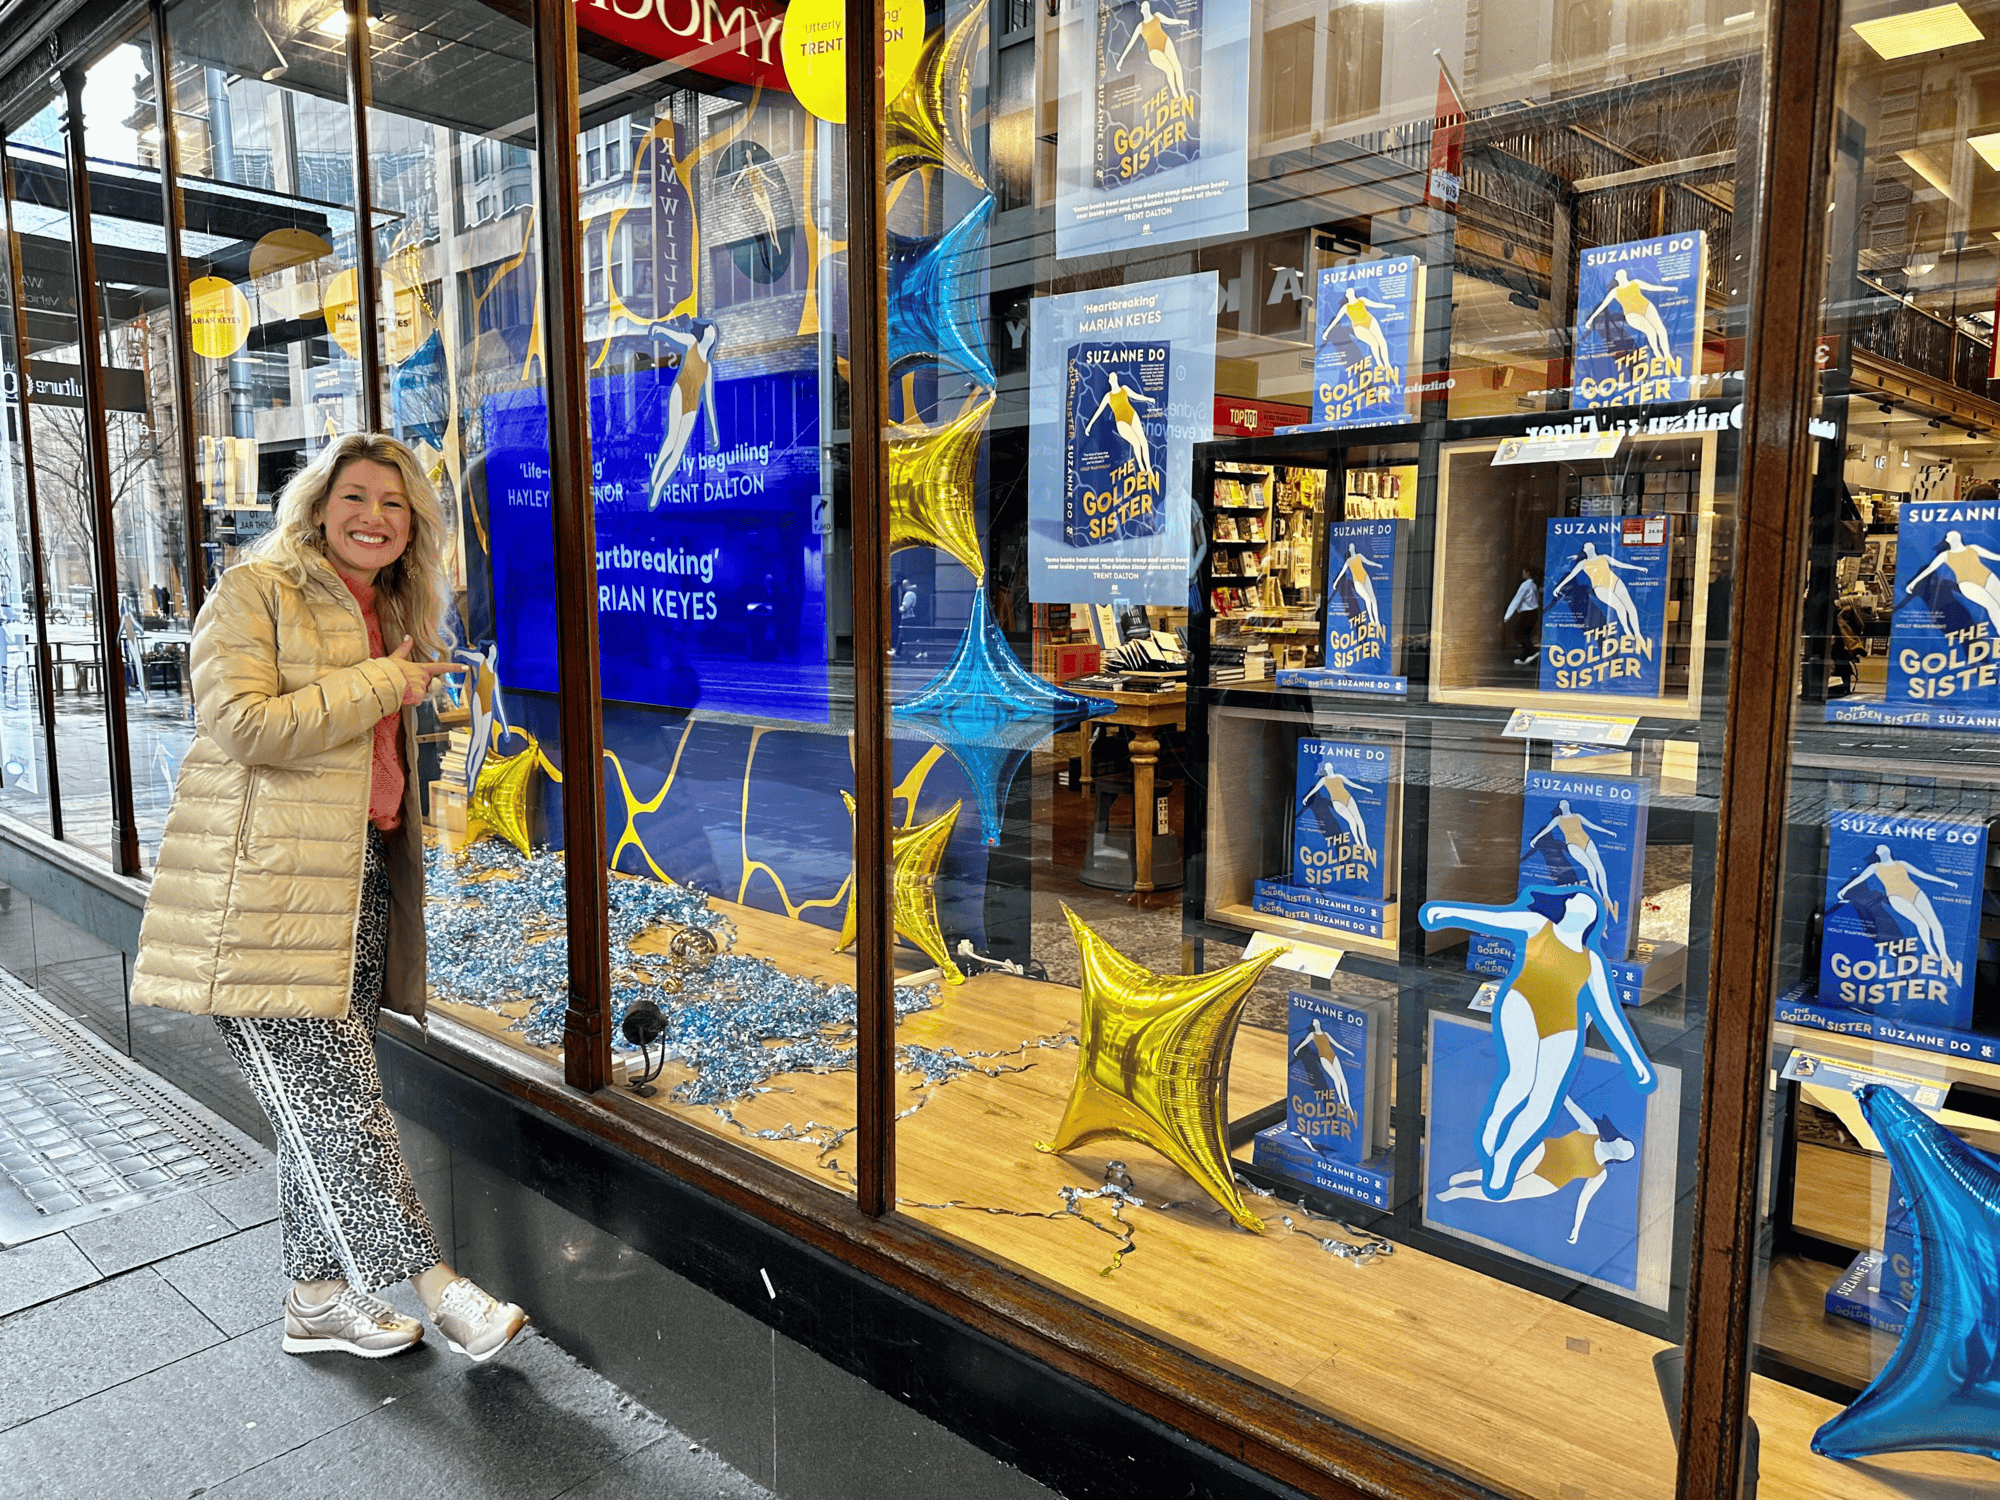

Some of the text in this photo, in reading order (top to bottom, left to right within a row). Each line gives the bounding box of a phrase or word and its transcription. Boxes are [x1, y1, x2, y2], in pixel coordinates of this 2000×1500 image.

[800, 37, 843, 57] TRENT
[1096, 83, 1105, 140] SUZANNE
[1141, 85, 1169, 118] THE
[1114, 95, 1195, 155] GOLDEN
[1096, 144, 1105, 162] DO
[1120, 121, 1187, 178] SISTER
[1119, 197, 1131, 206] and
[1147, 191, 1165, 201] books
[1181, 185, 1193, 195] and
[1210, 180, 1229, 189] books
[1123, 206, 1173, 222] TRENT DALTON
[1587, 243, 1663, 267] SUZANNE
[1668, 237, 1694, 254] DO
[1323, 265, 1383, 285] SUZANNE
[1388, 261, 1409, 276] DO
[1083, 294, 1159, 314] 'Heartbreaking'
[1079, 310, 1162, 333] MARIAN KEYES
[1086, 348, 1166, 364] SUZANNE DO
[1345, 355, 1373, 378] THE
[1614, 345, 1649, 372] THE
[1319, 366, 1400, 403] GOLDEN
[1580, 356, 1683, 400] GOLDEN
[1324, 386, 1391, 422] SISTER
[1067, 401, 1075, 439] SISTER
[698, 440, 774, 474] beguiling'
[1066, 445, 1075, 498] SUZANNE
[1109, 458, 1135, 485] THE
[508, 488, 550, 508] HAYLEY
[703, 473, 765, 502] DALTON
[1083, 471, 1161, 516] GOLDEN
[1066, 502, 1074, 519] DO
[1089, 494, 1153, 539] SISTER
[1908, 506, 2000, 523] SUZANN
[1333, 524, 1392, 537] SUZANNE DO
[1554, 522, 1621, 535] SUZANN
[1093, 572, 1139, 580] TRENT DALTON
[599, 584, 718, 621] RIAN KEYES
[1348, 610, 1367, 628] THE
[1583, 621, 1618, 643] THE
[1330, 621, 1387, 650] GOLDEN
[1944, 621, 1990, 647] THE
[1333, 641, 1381, 668] SISTER
[1548, 634, 1653, 668] GOLDEN
[1337, 678, 1375, 689] SUZANNE
[1377, 681, 1390, 690] DO
[1555, 657, 1642, 689] SISTER
[1907, 663, 2000, 699] SISTE
[1835, 710, 2000, 728] GOLDEN SISTER SUZANN
[1303, 744, 1385, 761] SUZANNE DO
[1533, 777, 1632, 800] SUZANNE DO
[1325, 831, 1350, 848] THE
[1840, 818, 1978, 846] SUZANNE DO
[1299, 843, 1377, 869] GOLDEN
[1305, 863, 1370, 885] SISTER
[1315, 897, 1352, 912] SUZANNE
[1353, 905, 1366, 914] DO
[1314, 913, 1350, 928] SUZANNE
[1353, 921, 1365, 931] DO
[1477, 944, 1511, 957] GOLDEN
[1875, 937, 1919, 957] THE
[1475, 963, 1509, 975] GOLDEN
[1830, 953, 1963, 988] GOLDEN
[1839, 979, 1949, 1006] SISTER
[1293, 996, 1364, 1027] SUZANNE DO
[1780, 1010, 1971, 1052] GOLDEN SISTER SUZANNE DO
[1314, 1088, 1335, 1100] THE
[1292, 1094, 1358, 1129] GOLDEN
[1297, 1115, 1352, 1142] SISTER
[1317, 1160, 1354, 1180] SUZANNE
[1357, 1173, 1370, 1185] DO
[1316, 1176, 1370, 1200] SUZANNE DO
[1836, 1262, 1870, 1297] SUZANNE
[1864, 1256, 1877, 1269] DO
